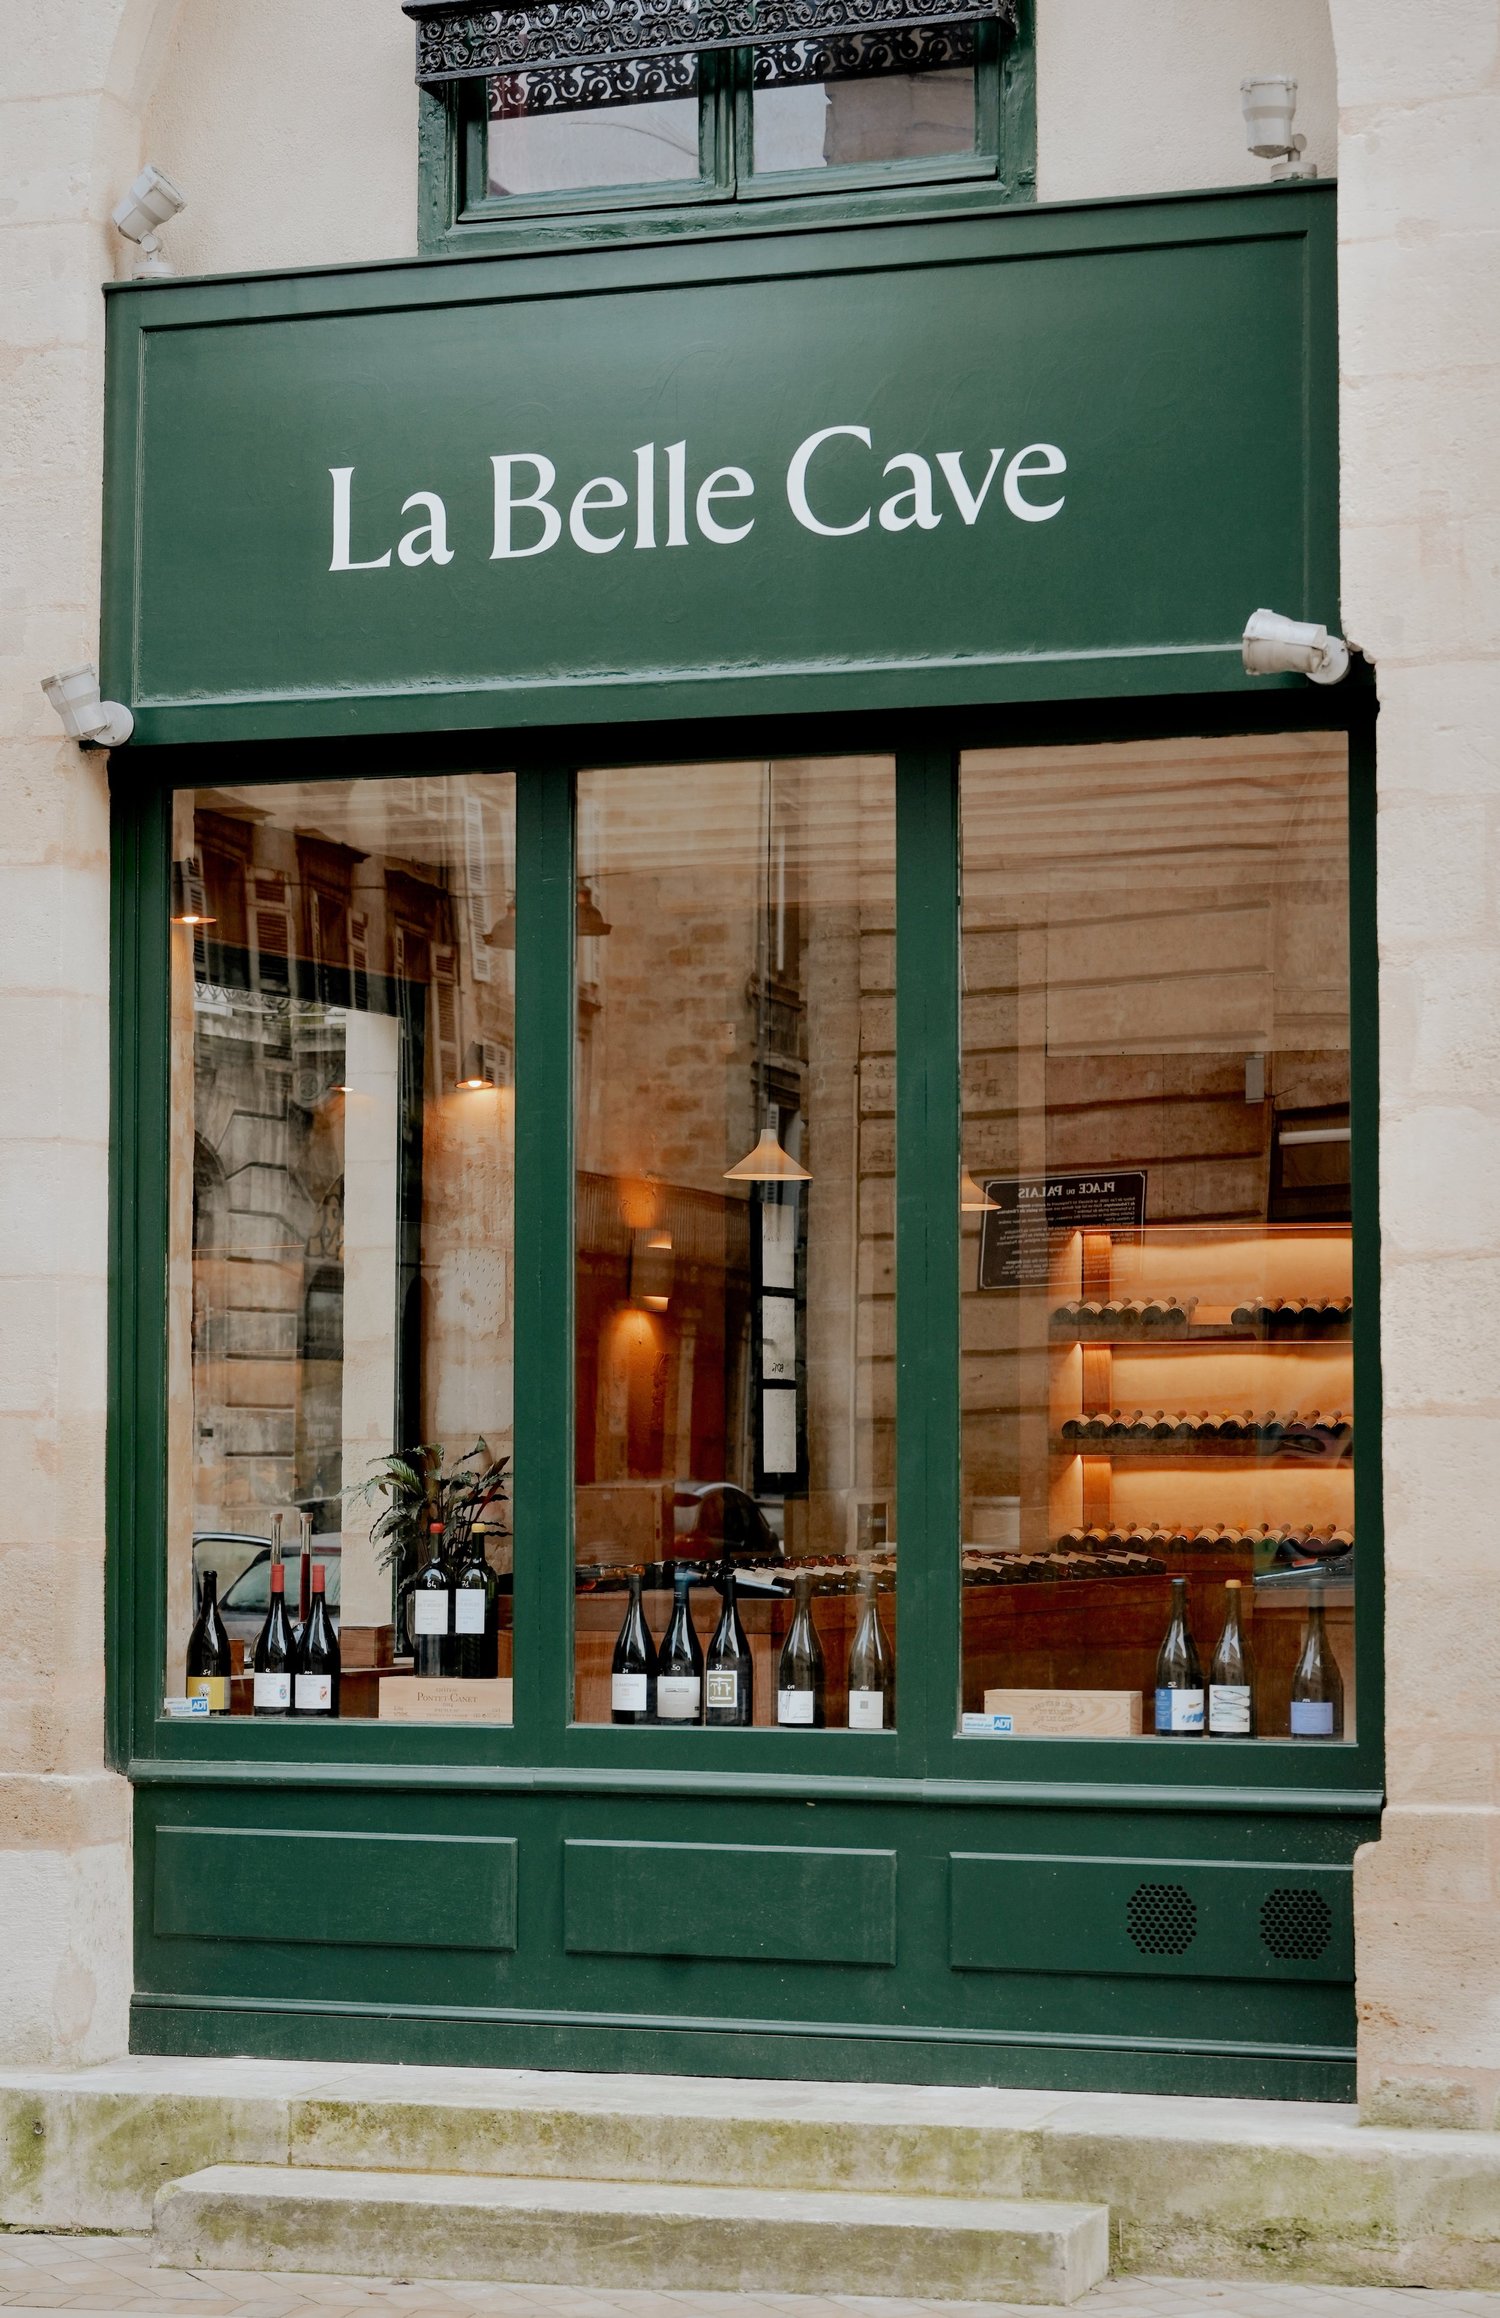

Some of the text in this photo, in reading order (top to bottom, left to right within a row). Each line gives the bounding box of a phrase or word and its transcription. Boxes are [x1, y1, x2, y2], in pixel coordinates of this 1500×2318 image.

[328, 425, 1067, 571] La Belle Cave
[193, 1701, 207, 1709] ADT
[995, 1719, 1011, 1728] ADT
